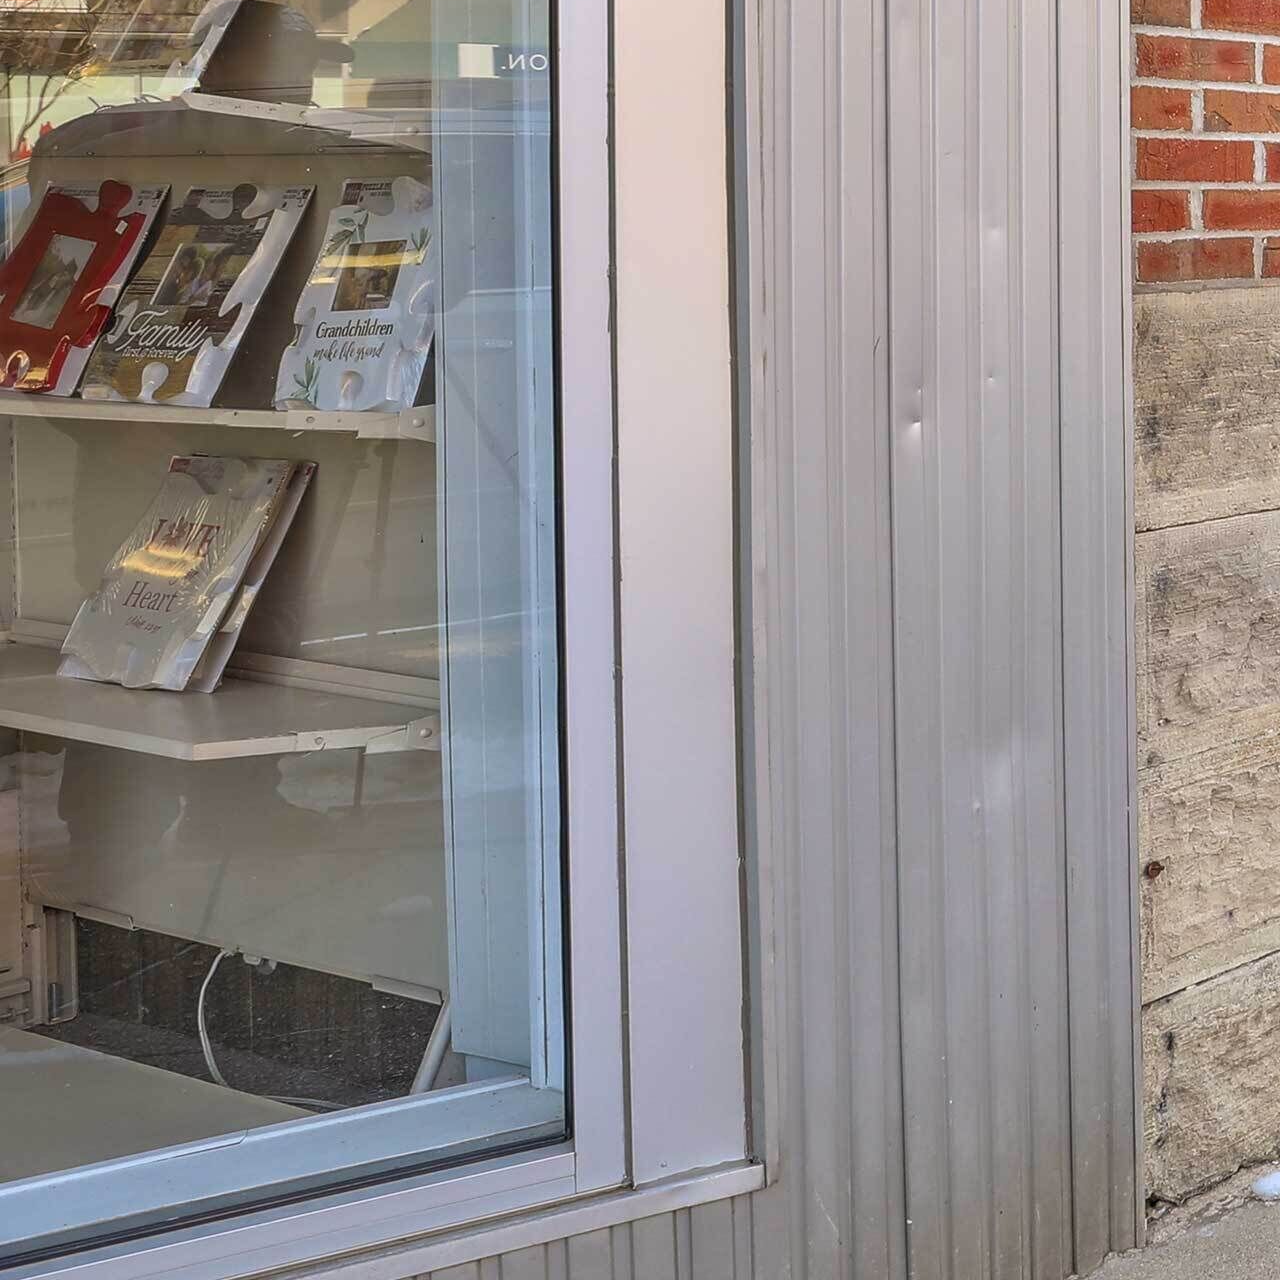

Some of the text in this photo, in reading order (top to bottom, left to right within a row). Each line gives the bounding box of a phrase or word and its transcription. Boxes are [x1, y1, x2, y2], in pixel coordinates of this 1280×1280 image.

[115, 310, 208, 362] Family
[316, 318, 394, 339] Grandchildren
[122, 580, 178, 613] Heart
